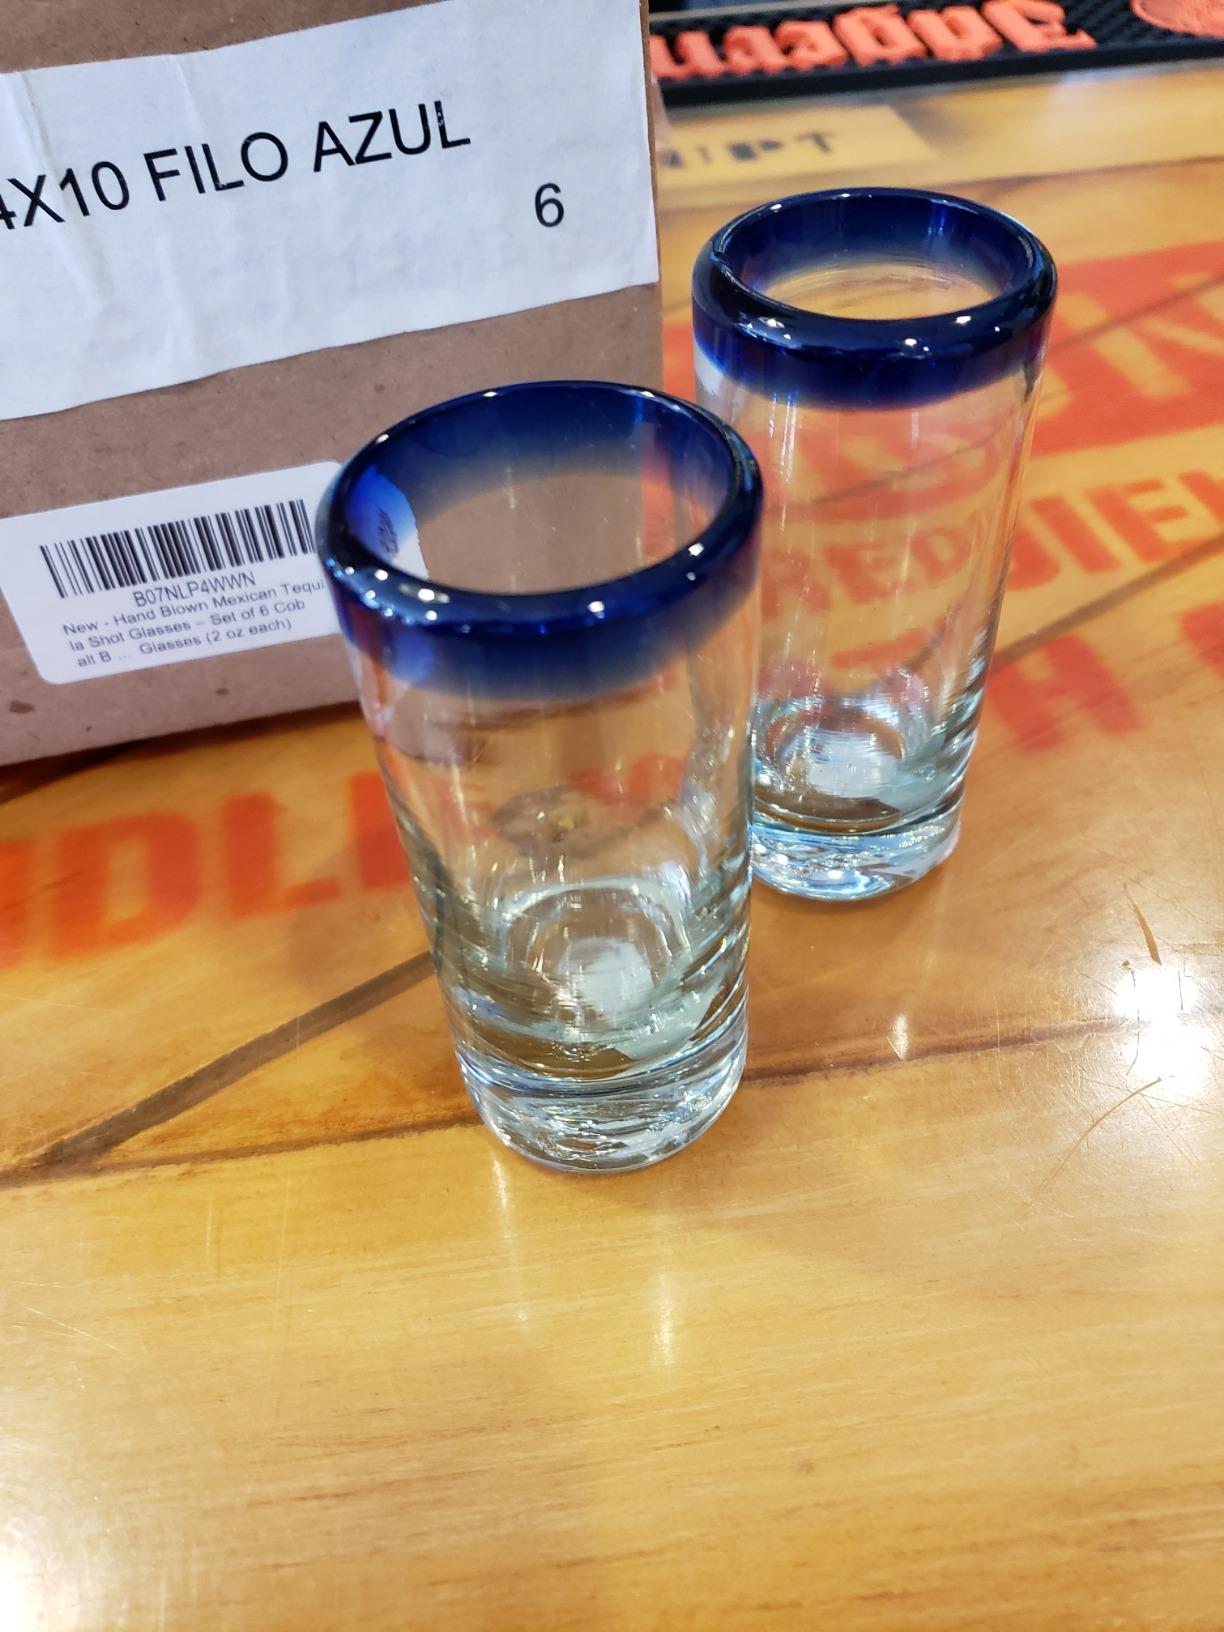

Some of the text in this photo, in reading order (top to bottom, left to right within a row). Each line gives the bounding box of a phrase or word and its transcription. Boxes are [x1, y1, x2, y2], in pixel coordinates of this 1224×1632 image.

[143, 132, 288, 201] FILO
[313, 100, 471, 173] AZUL
[534, 182, 565, 228] 6
[62, 621, 98, 635] New
[113, 609, 156, 626] Hand
[160, 601, 208, 618] Blown
[212, 588, 277, 608] Mexican
[280, 578, 325, 595] Tequi
[133, 571, 256, 607] B07NLP4WWN
[88, 631, 125, 648] Shot
[128, 621, 192, 640] Glasses
[210, 611, 237, 626] Set
[241, 607, 256, 620] of
[259, 604, 270, 617] 6
[274, 599, 306, 614] Cob
[99, 650, 112, 663] B
[139, 635, 202, 655] Glasses
[206, 630, 221, 645] (2
[226, 627, 245, 640] oz
[249, 618, 292, 635] each)
